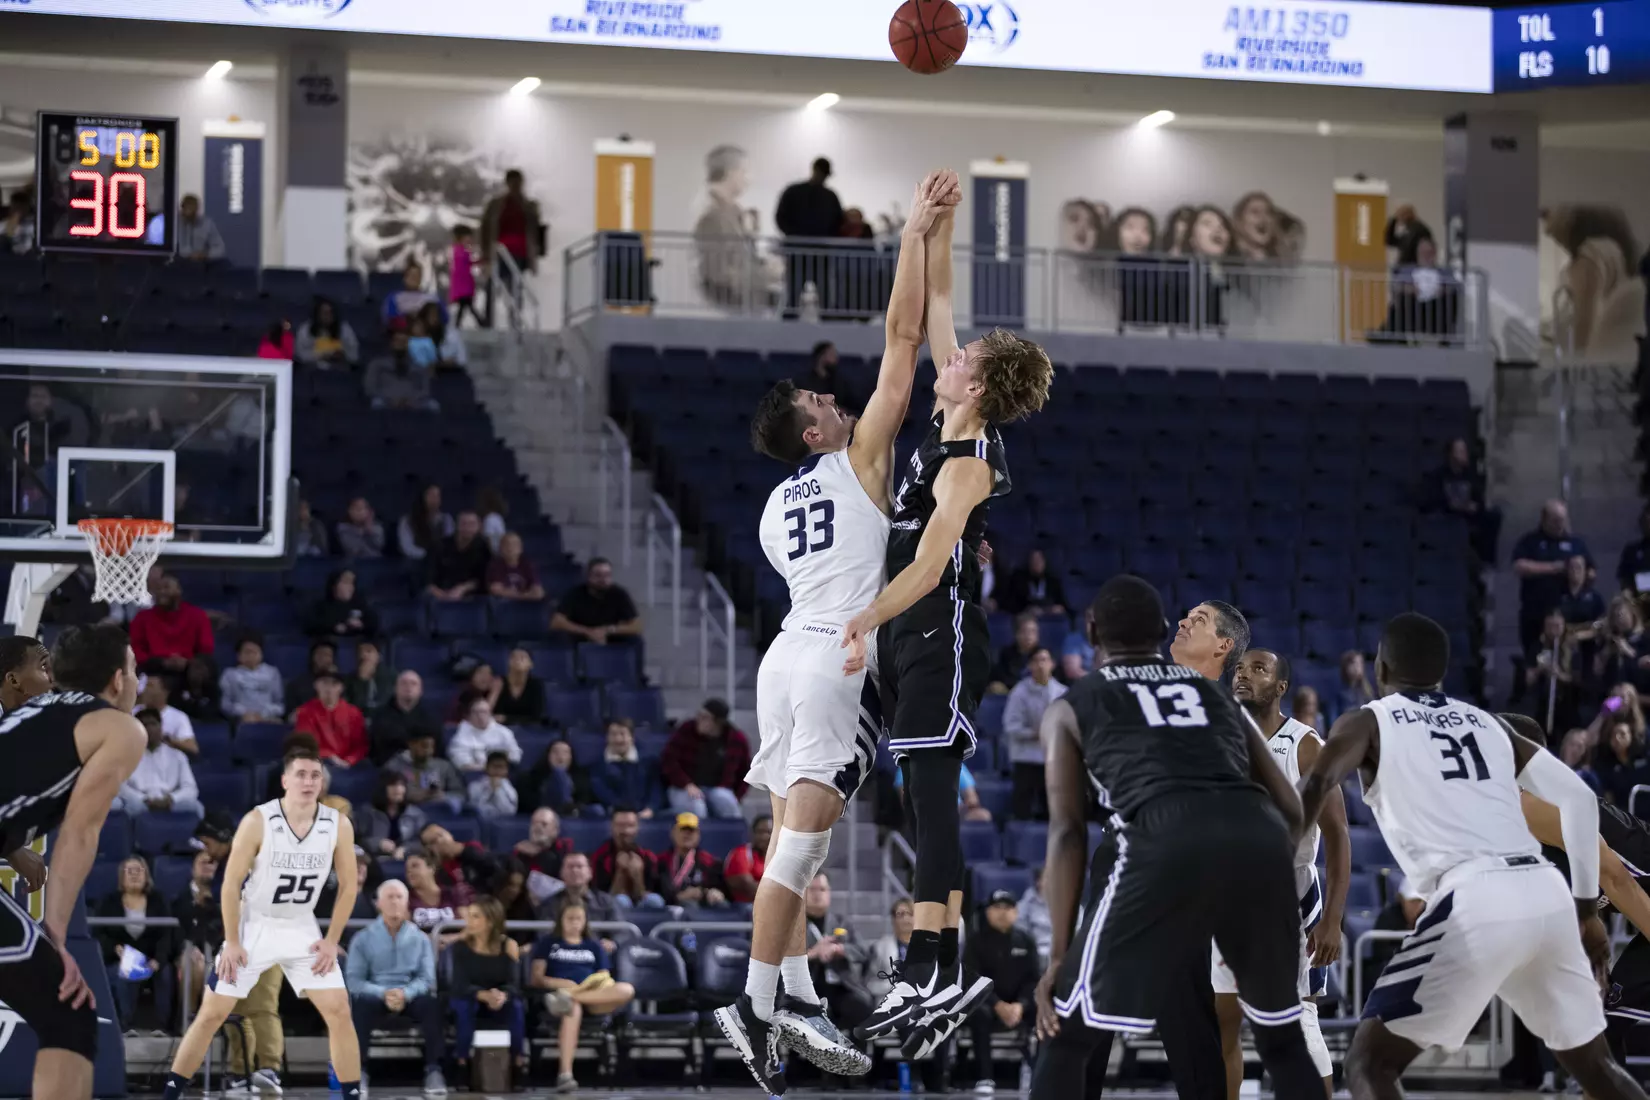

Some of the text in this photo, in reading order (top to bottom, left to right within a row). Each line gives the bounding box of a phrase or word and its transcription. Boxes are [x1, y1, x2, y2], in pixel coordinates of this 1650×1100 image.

[550, 17, 722, 41] SAN BERNARDINO
[1518, 7, 1604, 42] TOL 1
[1236, 37, 1331, 57] RIVERSIDE
[1519, 44, 1610, 78] FLS 10
[1202, 52, 1363, 76] SAN BERNARDINO
[70, 171, 146, 238] 30
[783, 478, 822, 505] PIROG
[784, 499, 835, 562] 33
[802, 624, 837, 636] LanceUp
[1126, 683, 1209, 726] 13
[1430, 730, 1491, 781] 31
[271, 850, 328, 869] LANCERS
[271, 873, 319, 904] 25
